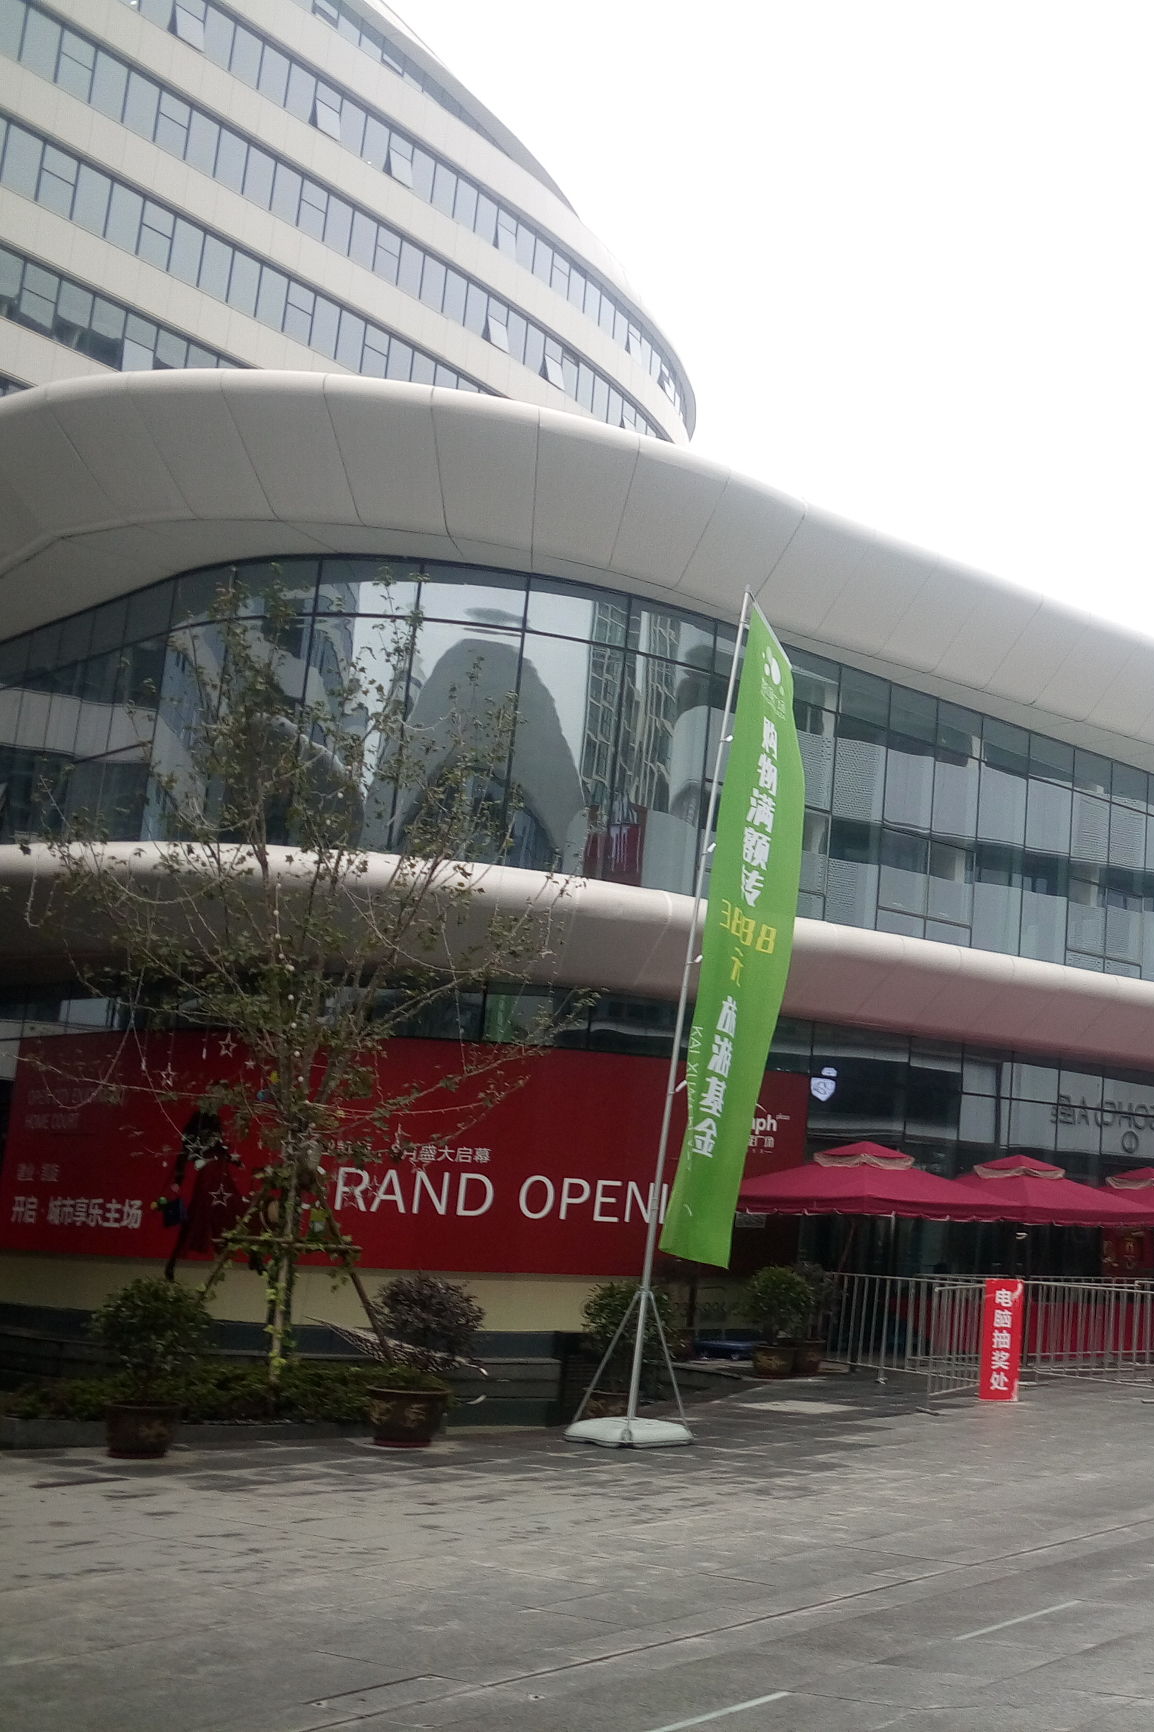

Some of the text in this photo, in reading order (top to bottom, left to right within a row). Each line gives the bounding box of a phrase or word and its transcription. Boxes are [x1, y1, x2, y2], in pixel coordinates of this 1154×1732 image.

[334, 1166, 669, 1225] RAND OPENI
[989, 1288, 1013, 1391] 电脑抽奖处
